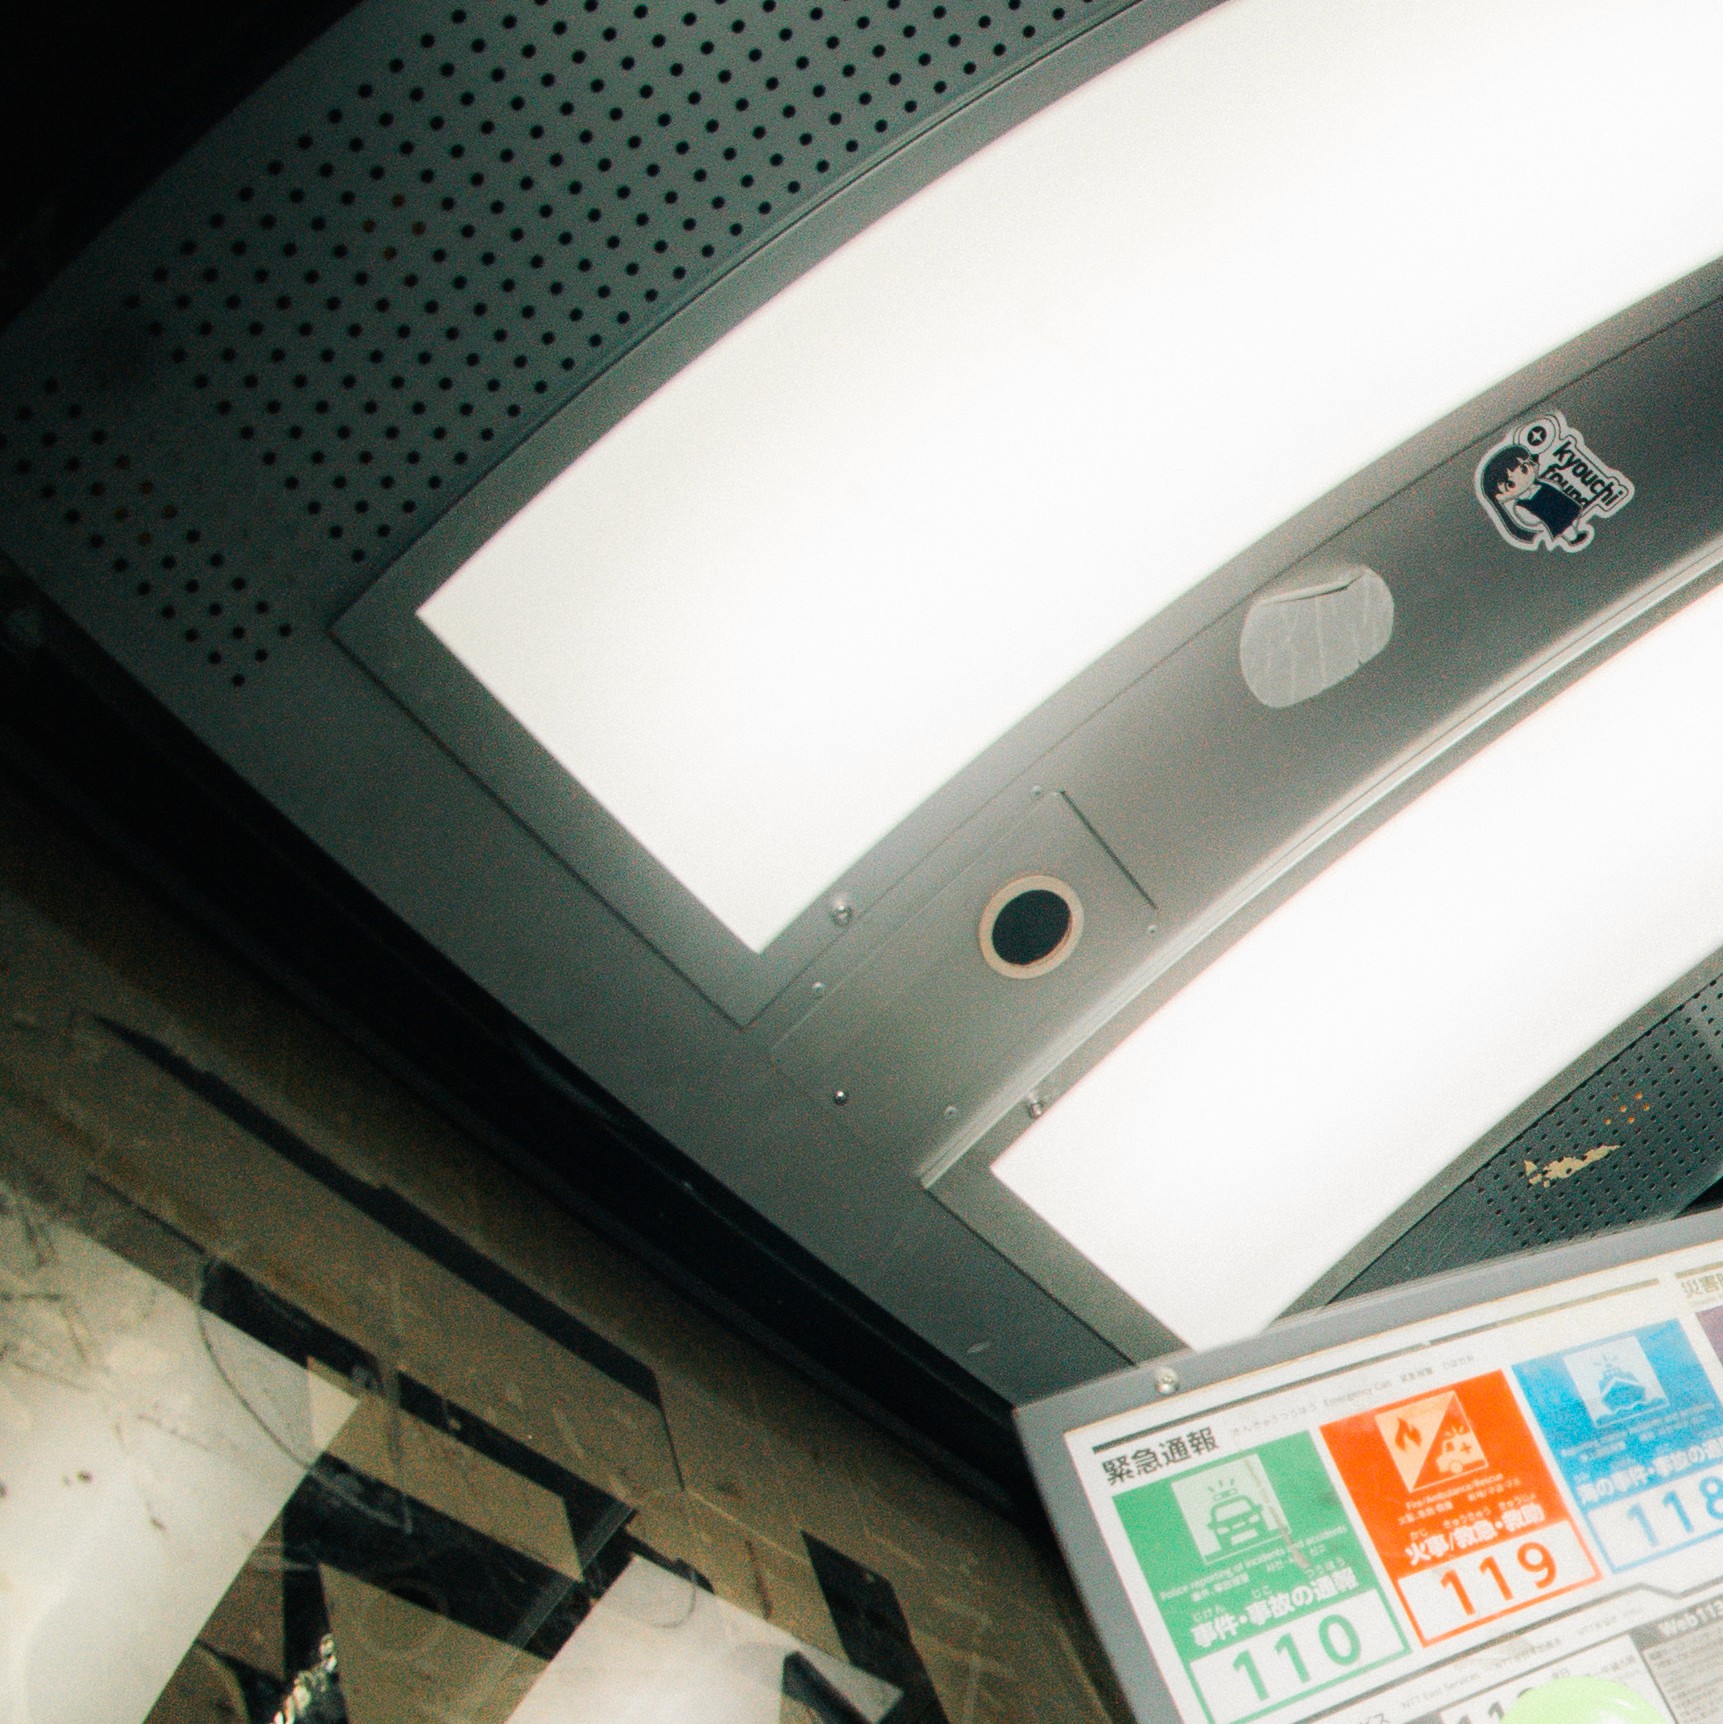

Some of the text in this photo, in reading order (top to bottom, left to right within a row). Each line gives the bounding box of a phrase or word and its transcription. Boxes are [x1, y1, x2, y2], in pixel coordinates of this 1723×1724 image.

[1553, 441, 1624, 507] kyouchi
[1101, 1427, 1216, 1485] 緊急通報
[1440, 1541, 1556, 1615] 119
[1232, 1614, 1360, 1699] 110
